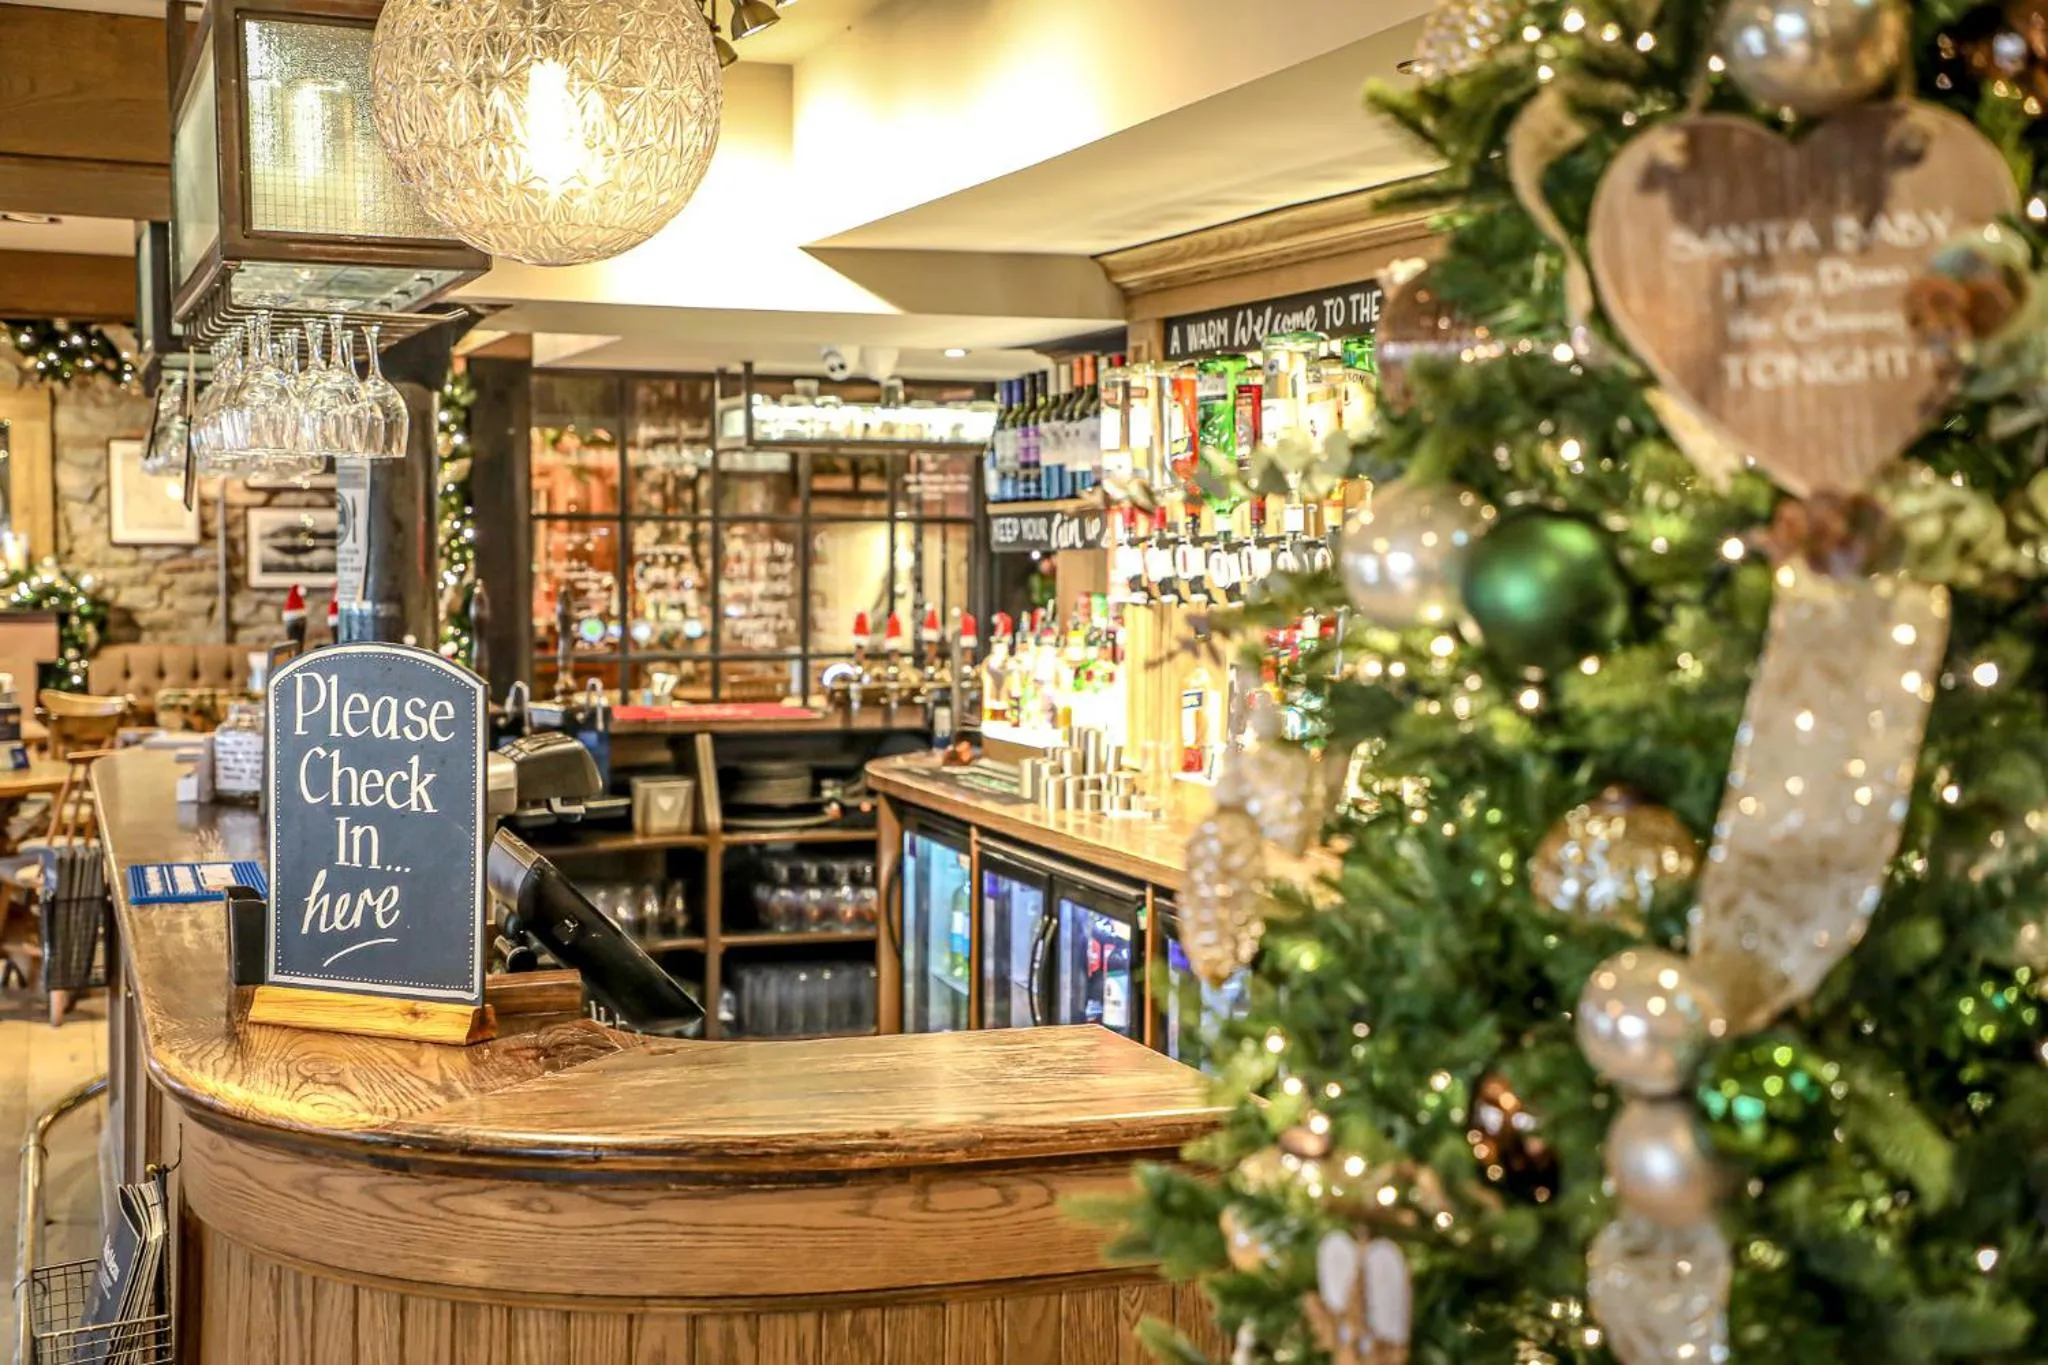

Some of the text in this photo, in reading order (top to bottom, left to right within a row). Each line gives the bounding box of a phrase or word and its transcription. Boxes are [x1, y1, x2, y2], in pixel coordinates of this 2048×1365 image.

[1169, 289, 1382, 356] A WARM Welcome TO THE
[991, 517, 1019, 543] KEEP
[1020, 517, 1049, 541] YOUR
[294, 671, 456, 743] Please
[300, 746, 439, 814] Check
[300, 868, 400, 936] here
